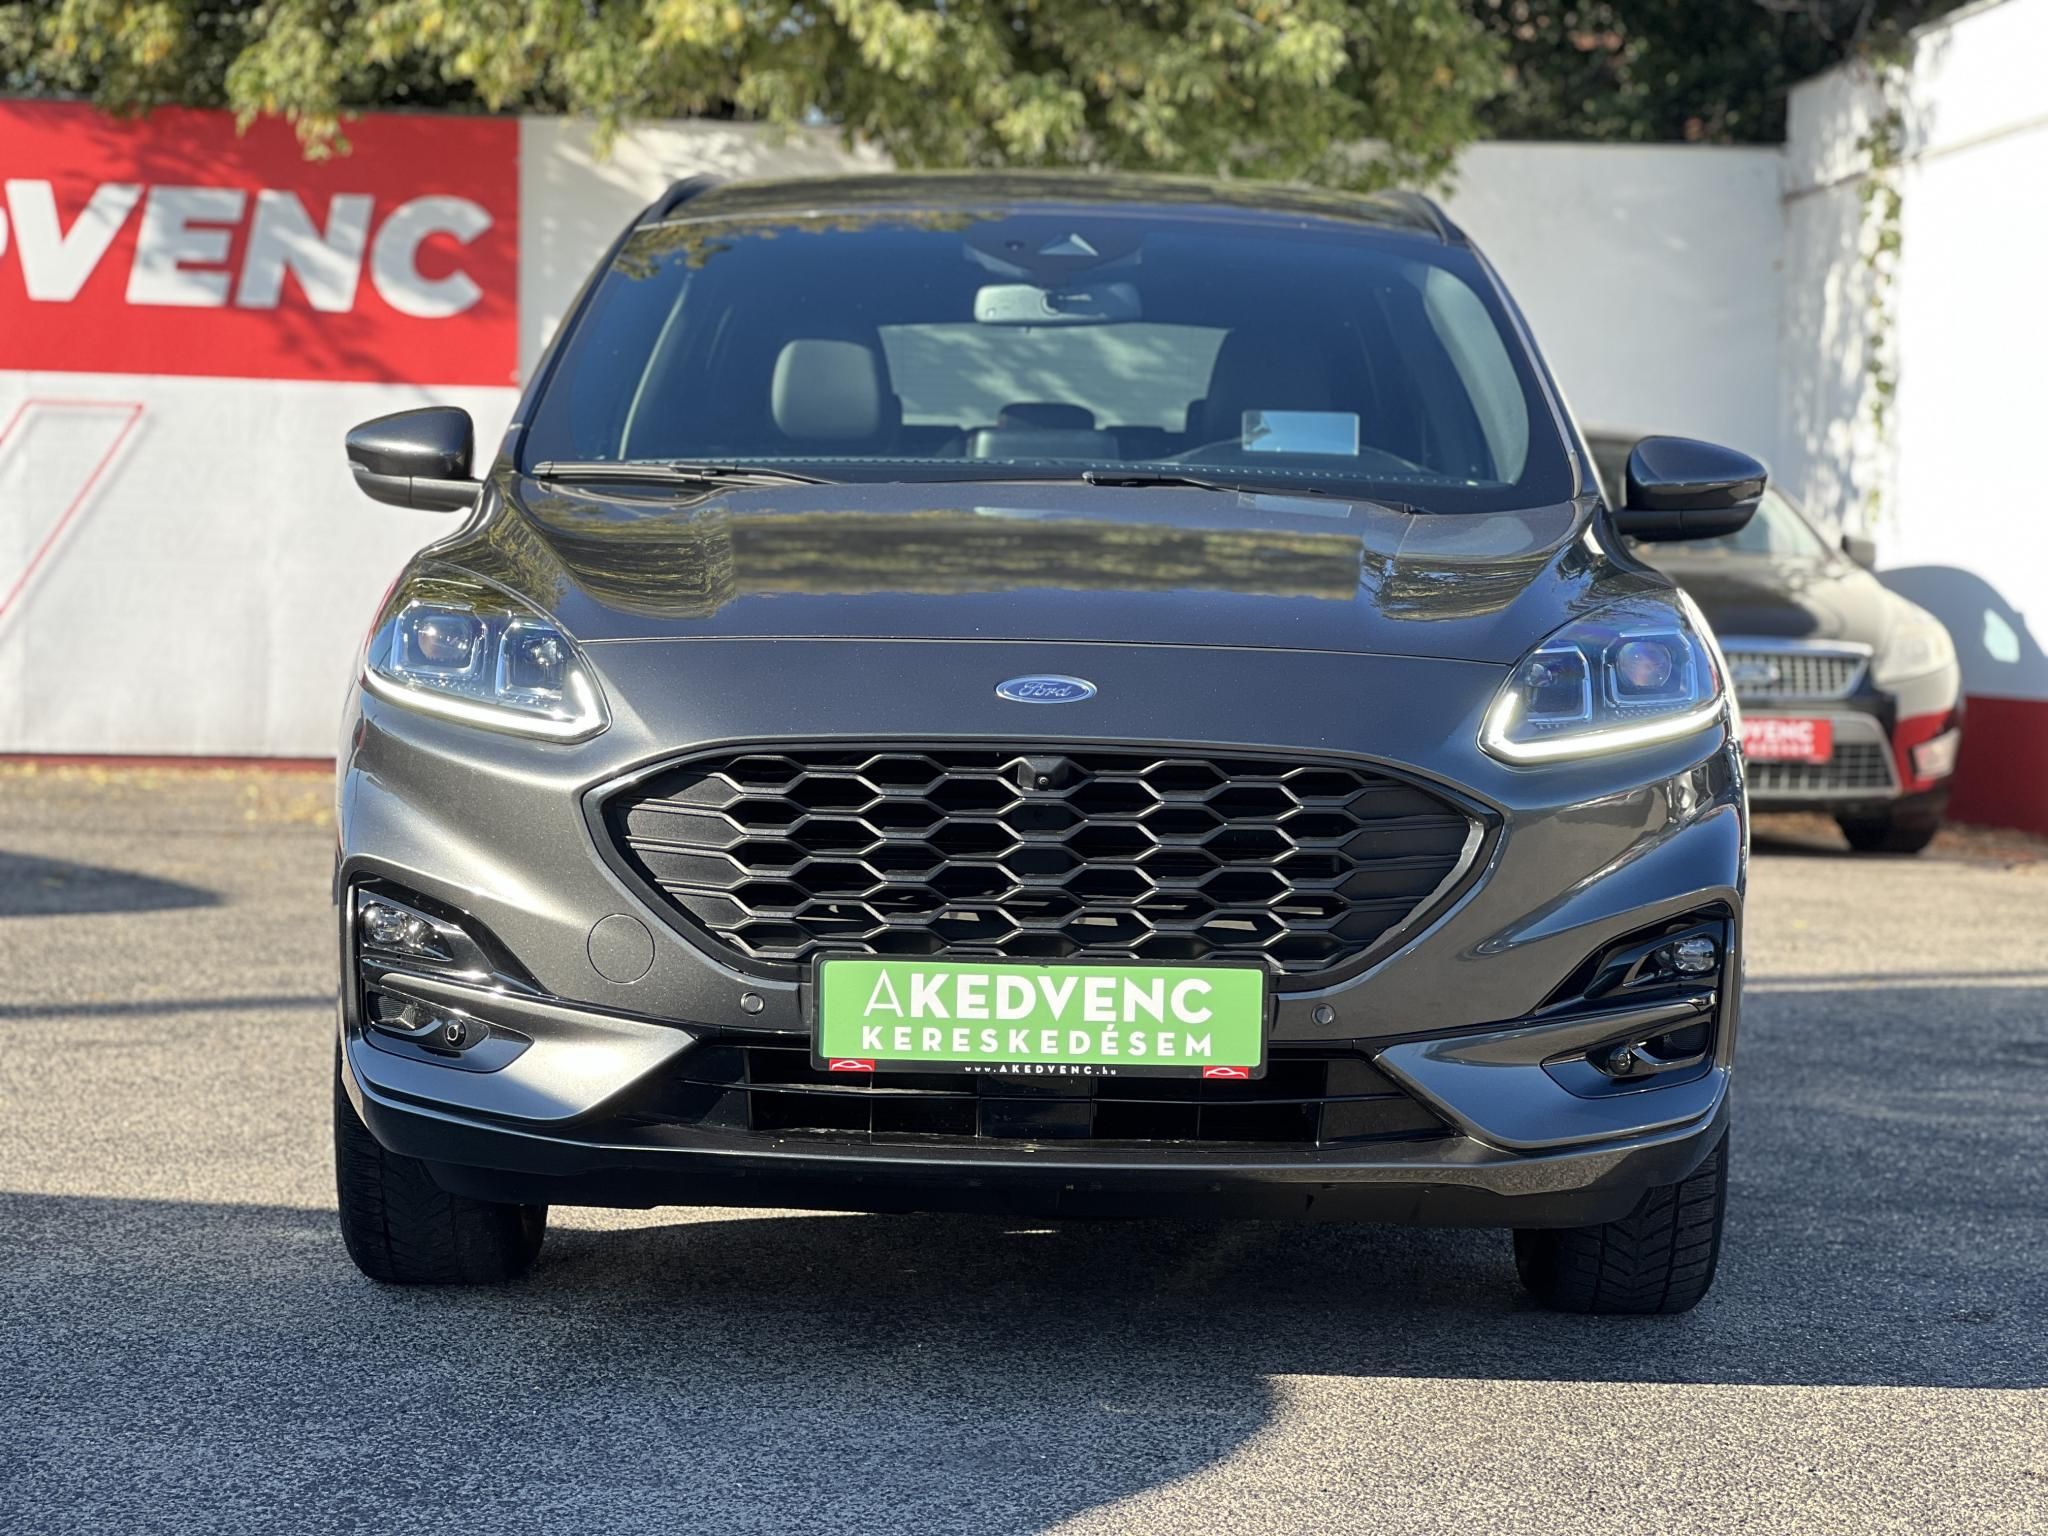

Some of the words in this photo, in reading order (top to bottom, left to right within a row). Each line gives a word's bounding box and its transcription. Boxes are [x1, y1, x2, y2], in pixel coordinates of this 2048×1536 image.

[0, 180, 494, 318] VENC
[1018, 681, 1073, 697] Ford
[863, 968, 1213, 1024] AKEDVENC
[862, 1023, 1212, 1057] KERESKEDÉSEM
[964, 1064, 1117, 1076] www.AKEDVENC.hu
